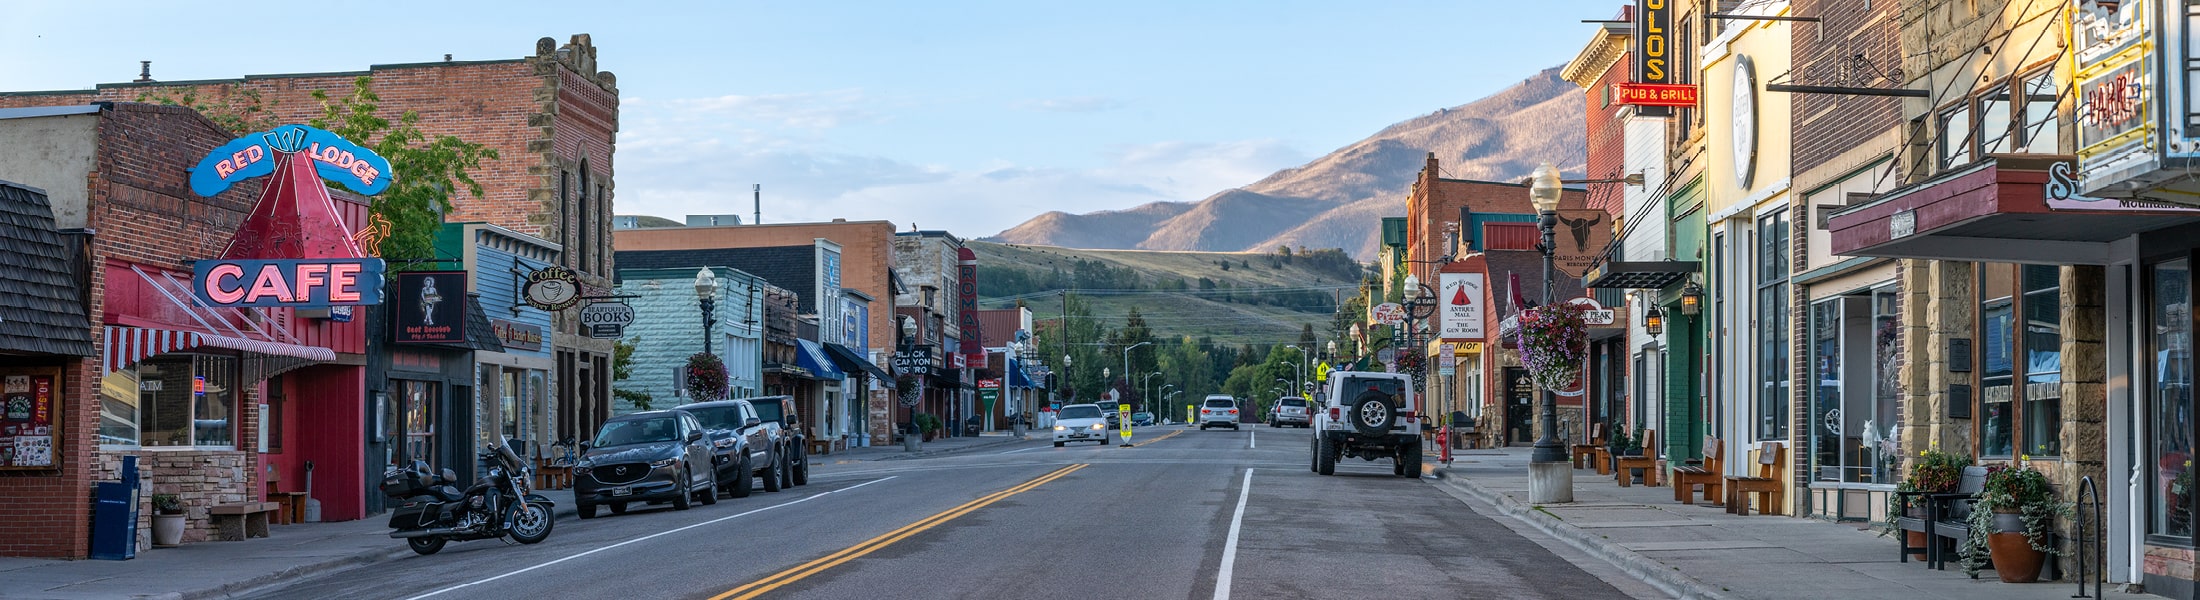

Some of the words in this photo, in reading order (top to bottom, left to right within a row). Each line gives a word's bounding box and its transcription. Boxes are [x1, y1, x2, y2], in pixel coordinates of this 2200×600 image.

[1622, 89, 1647, 99] PUB
[1649, 90, 1658, 100] &
[1661, 89, 1694, 100] GRILL
[214, 144, 264, 180] RED
[309, 142, 380, 186] LODGE
[529, 266, 576, 283] Coffee
[205, 263, 361, 304] CAFE
[1445, 281, 1458, 290] RED
[524, 294, 548, 311] Factory
[961, 266, 976, 340] ROMAN
[583, 312, 630, 323] BOOKS
[1590, 311, 1612, 320] PEAK
[140, 381, 162, 391] ATM
